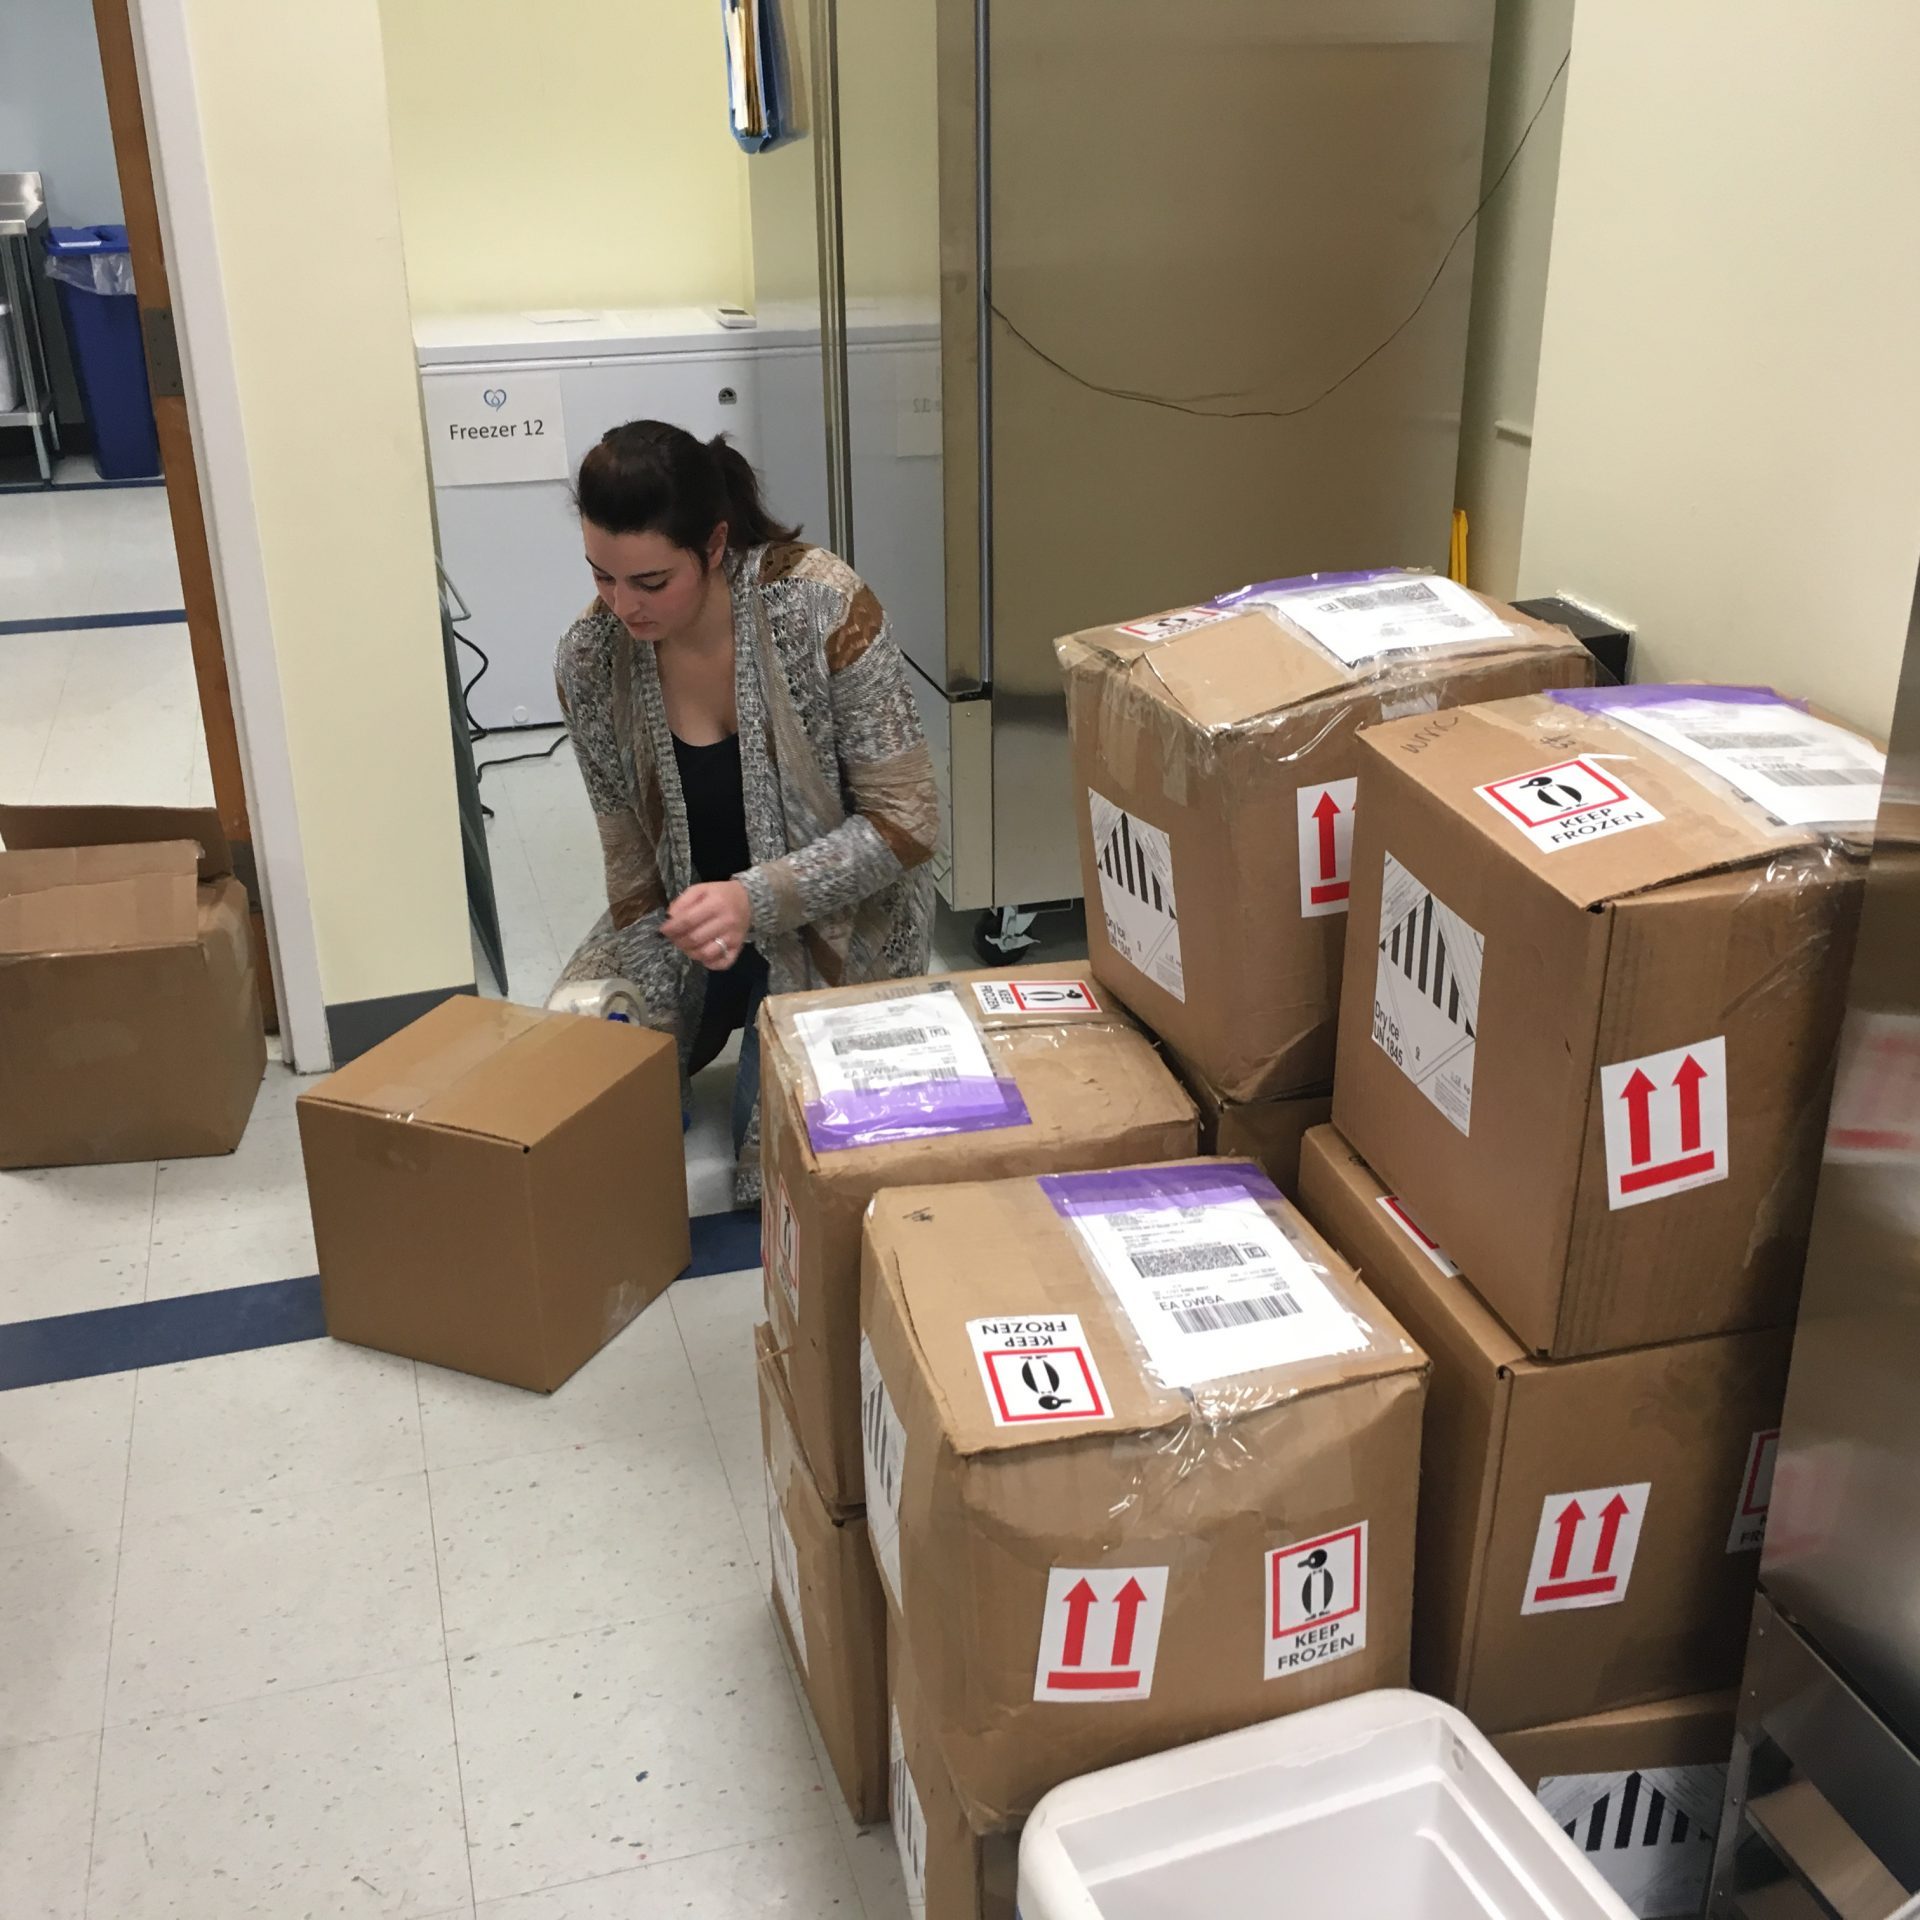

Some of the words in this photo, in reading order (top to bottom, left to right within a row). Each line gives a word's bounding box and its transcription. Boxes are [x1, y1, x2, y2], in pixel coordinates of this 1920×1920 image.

[449, 423, 517, 440] Freezer
[523, 419, 544, 436] 12
[1550, 811, 1645, 843] FROZEN
[1559, 808, 1611, 828] KEEP
[1375, 1000, 1388, 1031] Dry
[1388, 1015, 1400, 1041] Ice
[1374, 1021, 1385, 1047] UN
[1386, 1035, 1403, 1067] 1845
[1159, 1300, 1180, 1312] EA
[981, 1321, 1067, 1335] FROZEN
[1004, 1335, 1054, 1347] KEEP
[1295, 1623, 1340, 1649] KEEP
[1278, 1633, 1354, 1670] FROZEN
